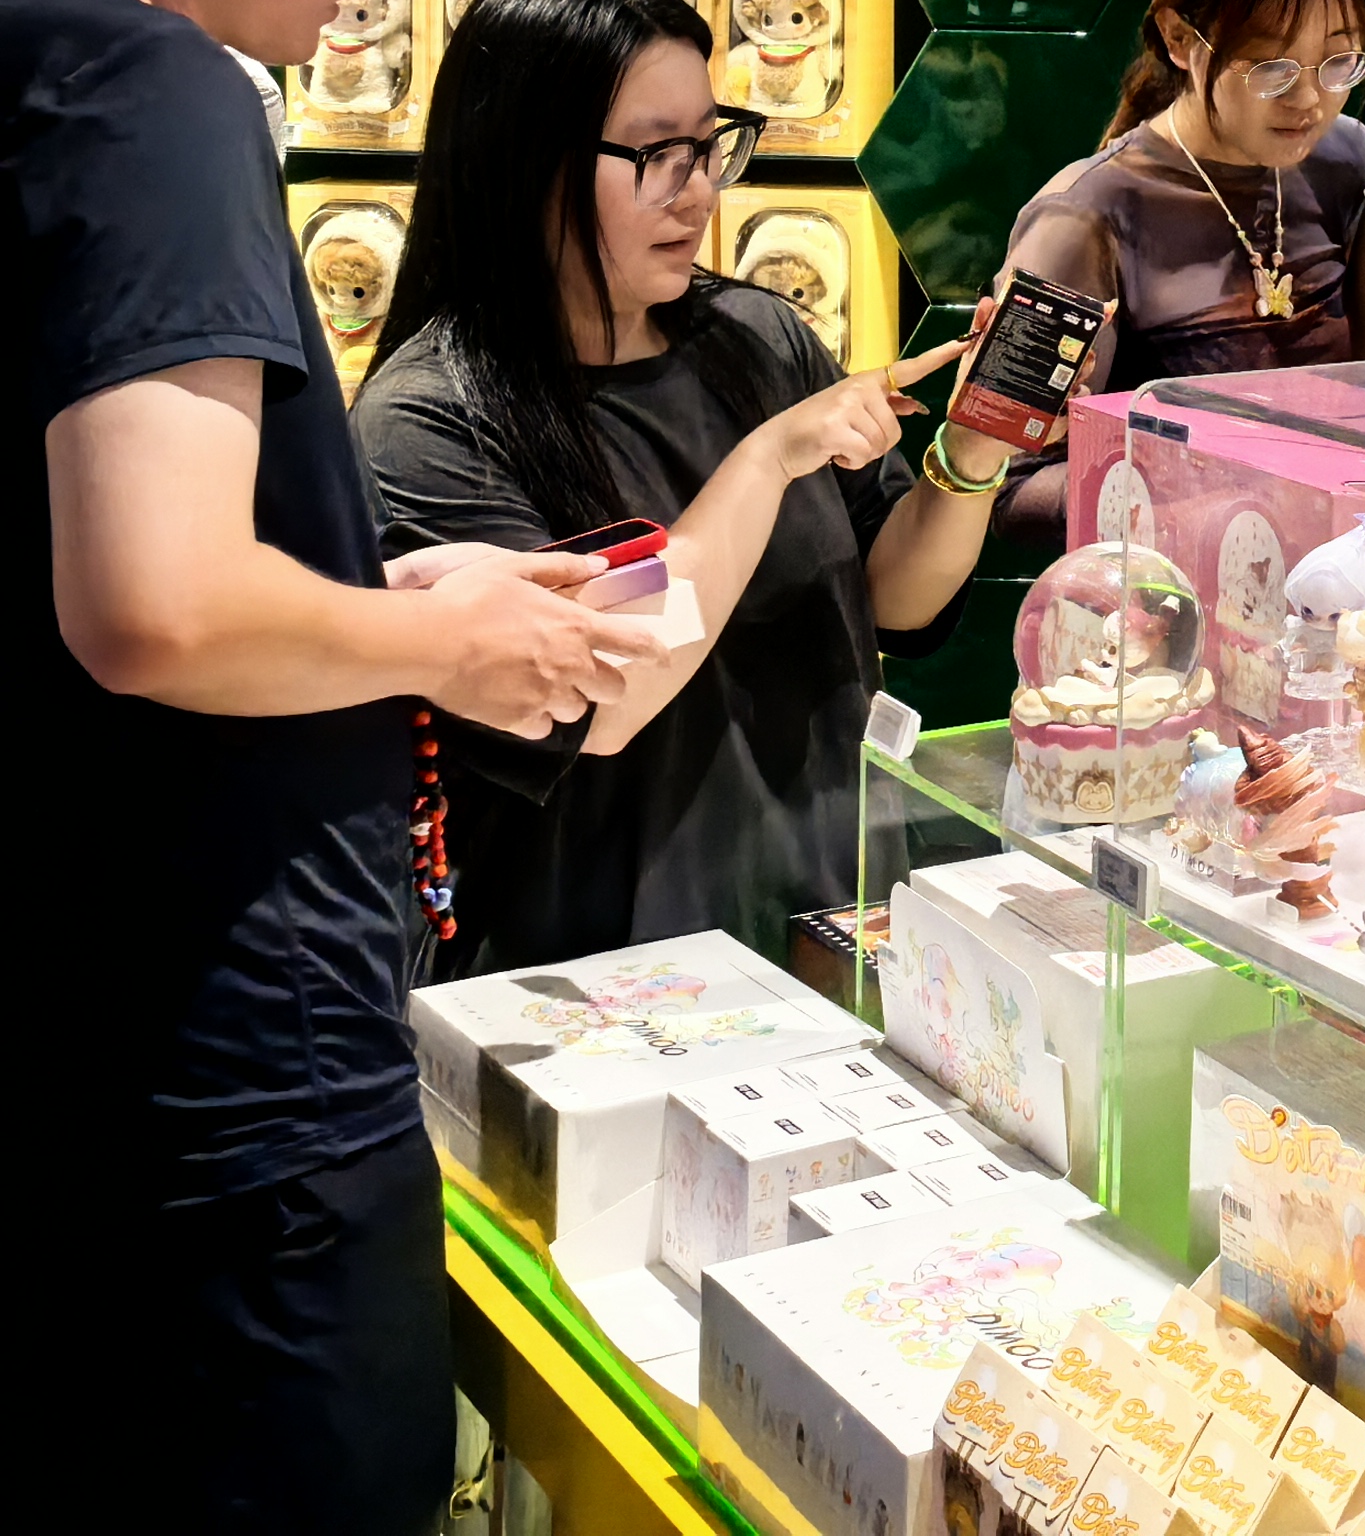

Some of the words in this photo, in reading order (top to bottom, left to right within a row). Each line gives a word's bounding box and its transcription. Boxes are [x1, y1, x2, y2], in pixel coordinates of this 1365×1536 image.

[620, 1019, 688, 1056] DIMOO
[964, 1313, 1054, 1370] DIMOO
[946, 1380, 1015, 1456] Dating
[1004, 1431, 1079, 1511] Dating
